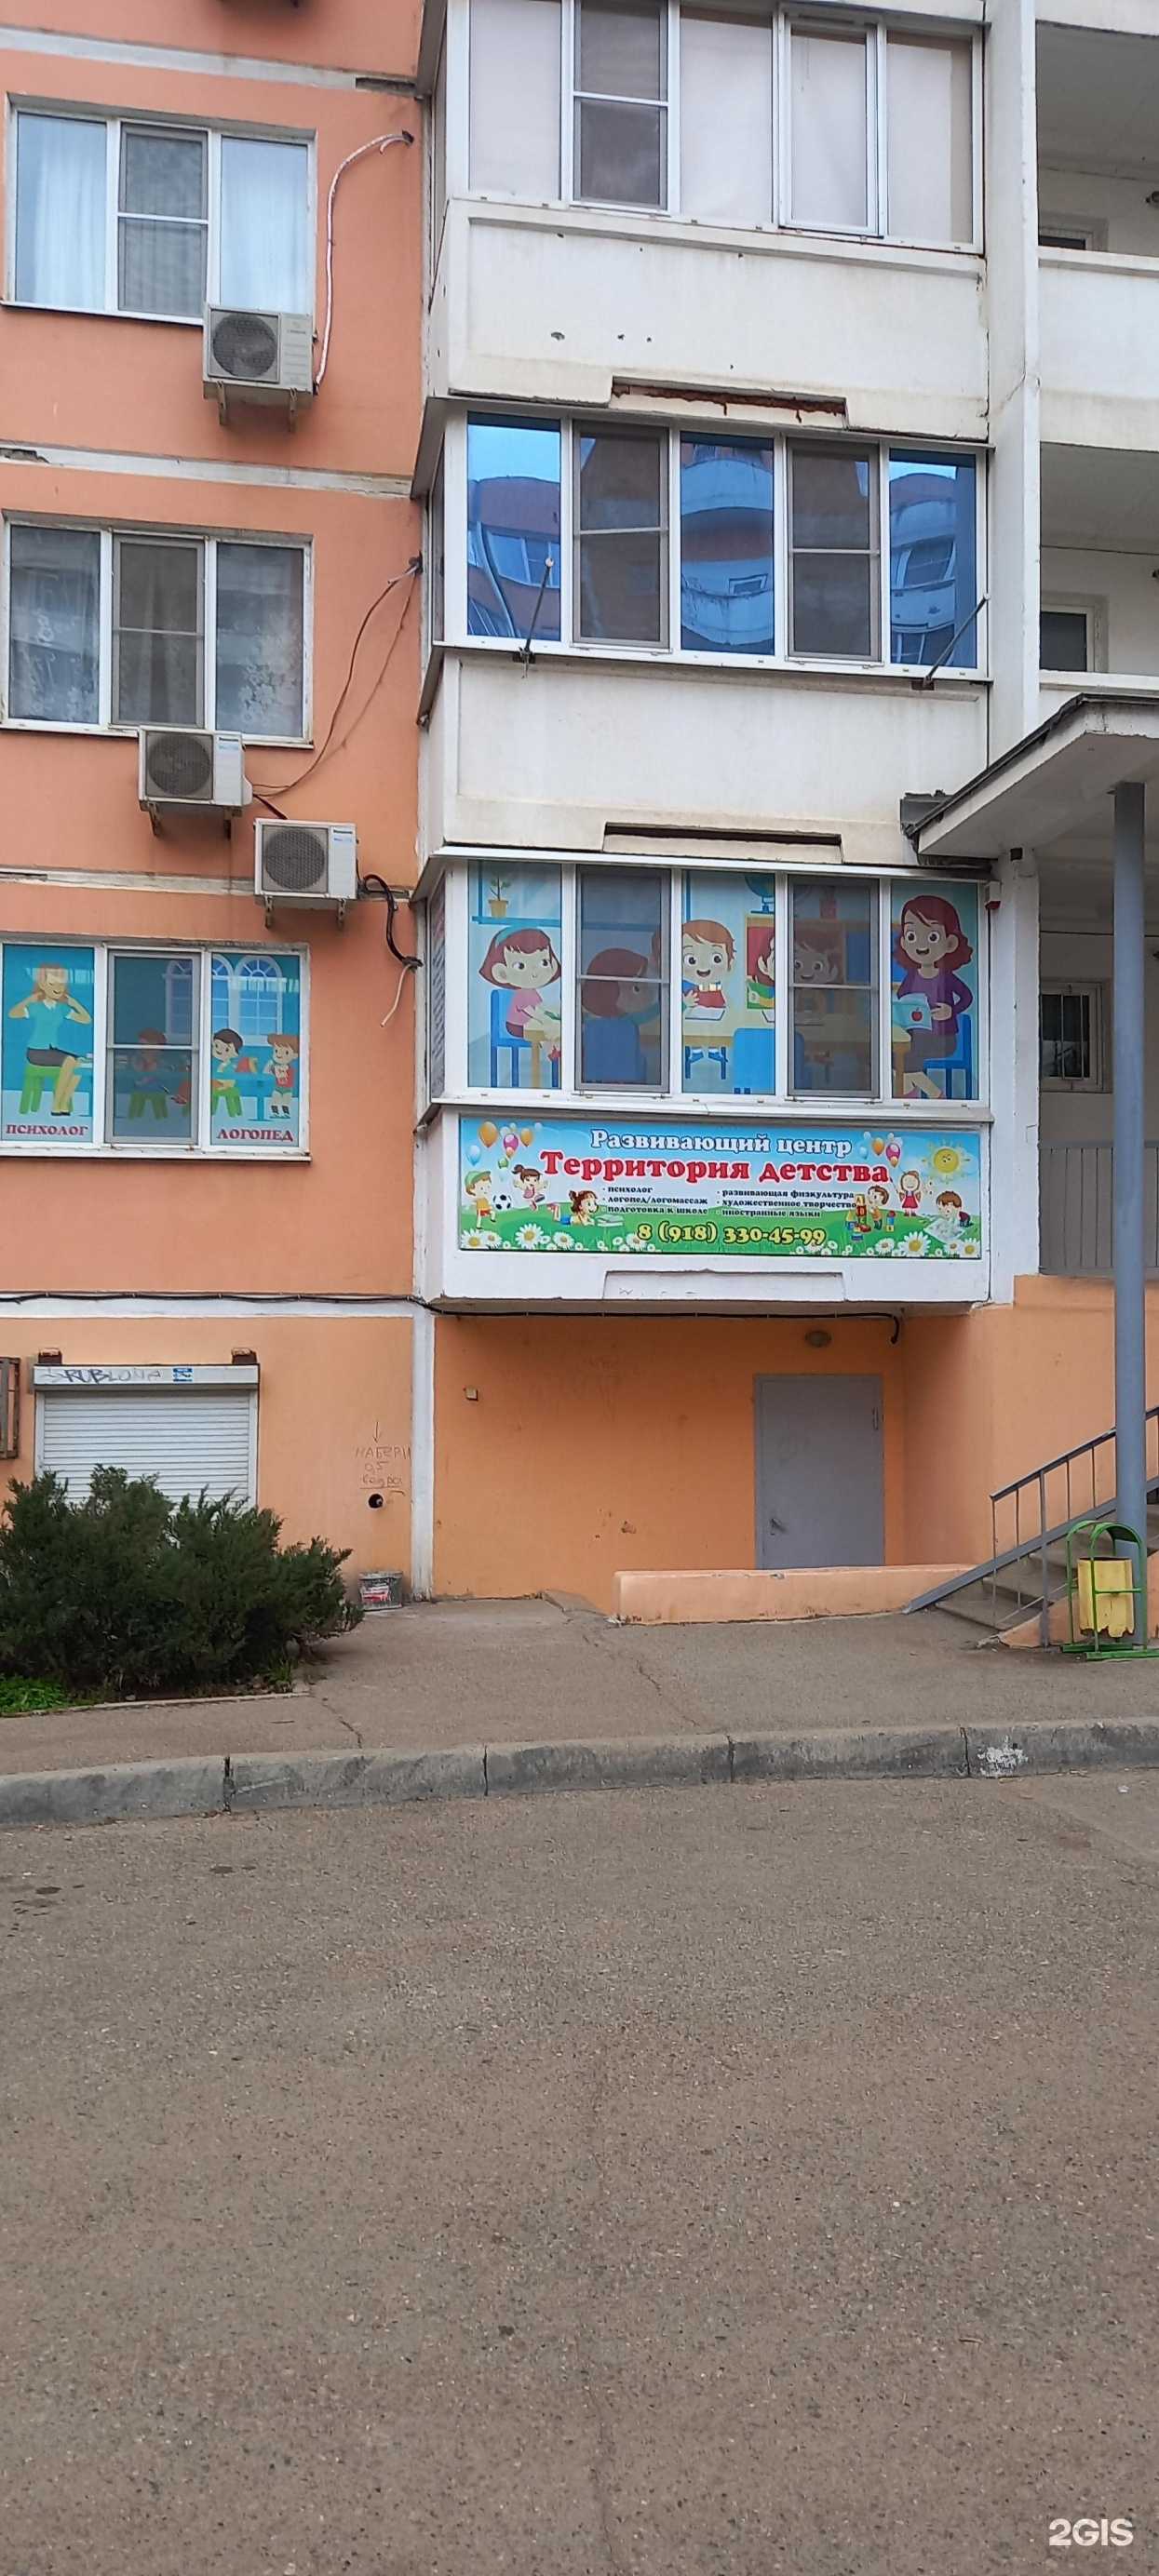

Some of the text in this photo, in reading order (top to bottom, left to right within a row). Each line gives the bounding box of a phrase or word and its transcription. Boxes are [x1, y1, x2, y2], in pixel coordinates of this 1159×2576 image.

[7, 1124, 88, 1135] ПСИХОЛОГ
[216, 1128, 293, 1142] ЛОГОПЕД
[591, 1129, 853, 1158] Развивающий центр
[540, 1150, 890, 1184] Территория детства
[721, 1189, 855, 1200] развивающая физкультура
[608, 1196, 708, 1205] логопед/логомассаж
[721, 1199, 856, 1209] художественное творчество
[608, 1206, 665, 1214] подготовка
[721, 1209, 787, 1218] иностранные
[638, 1220, 827, 1246] 8 (918) 330-45-99
